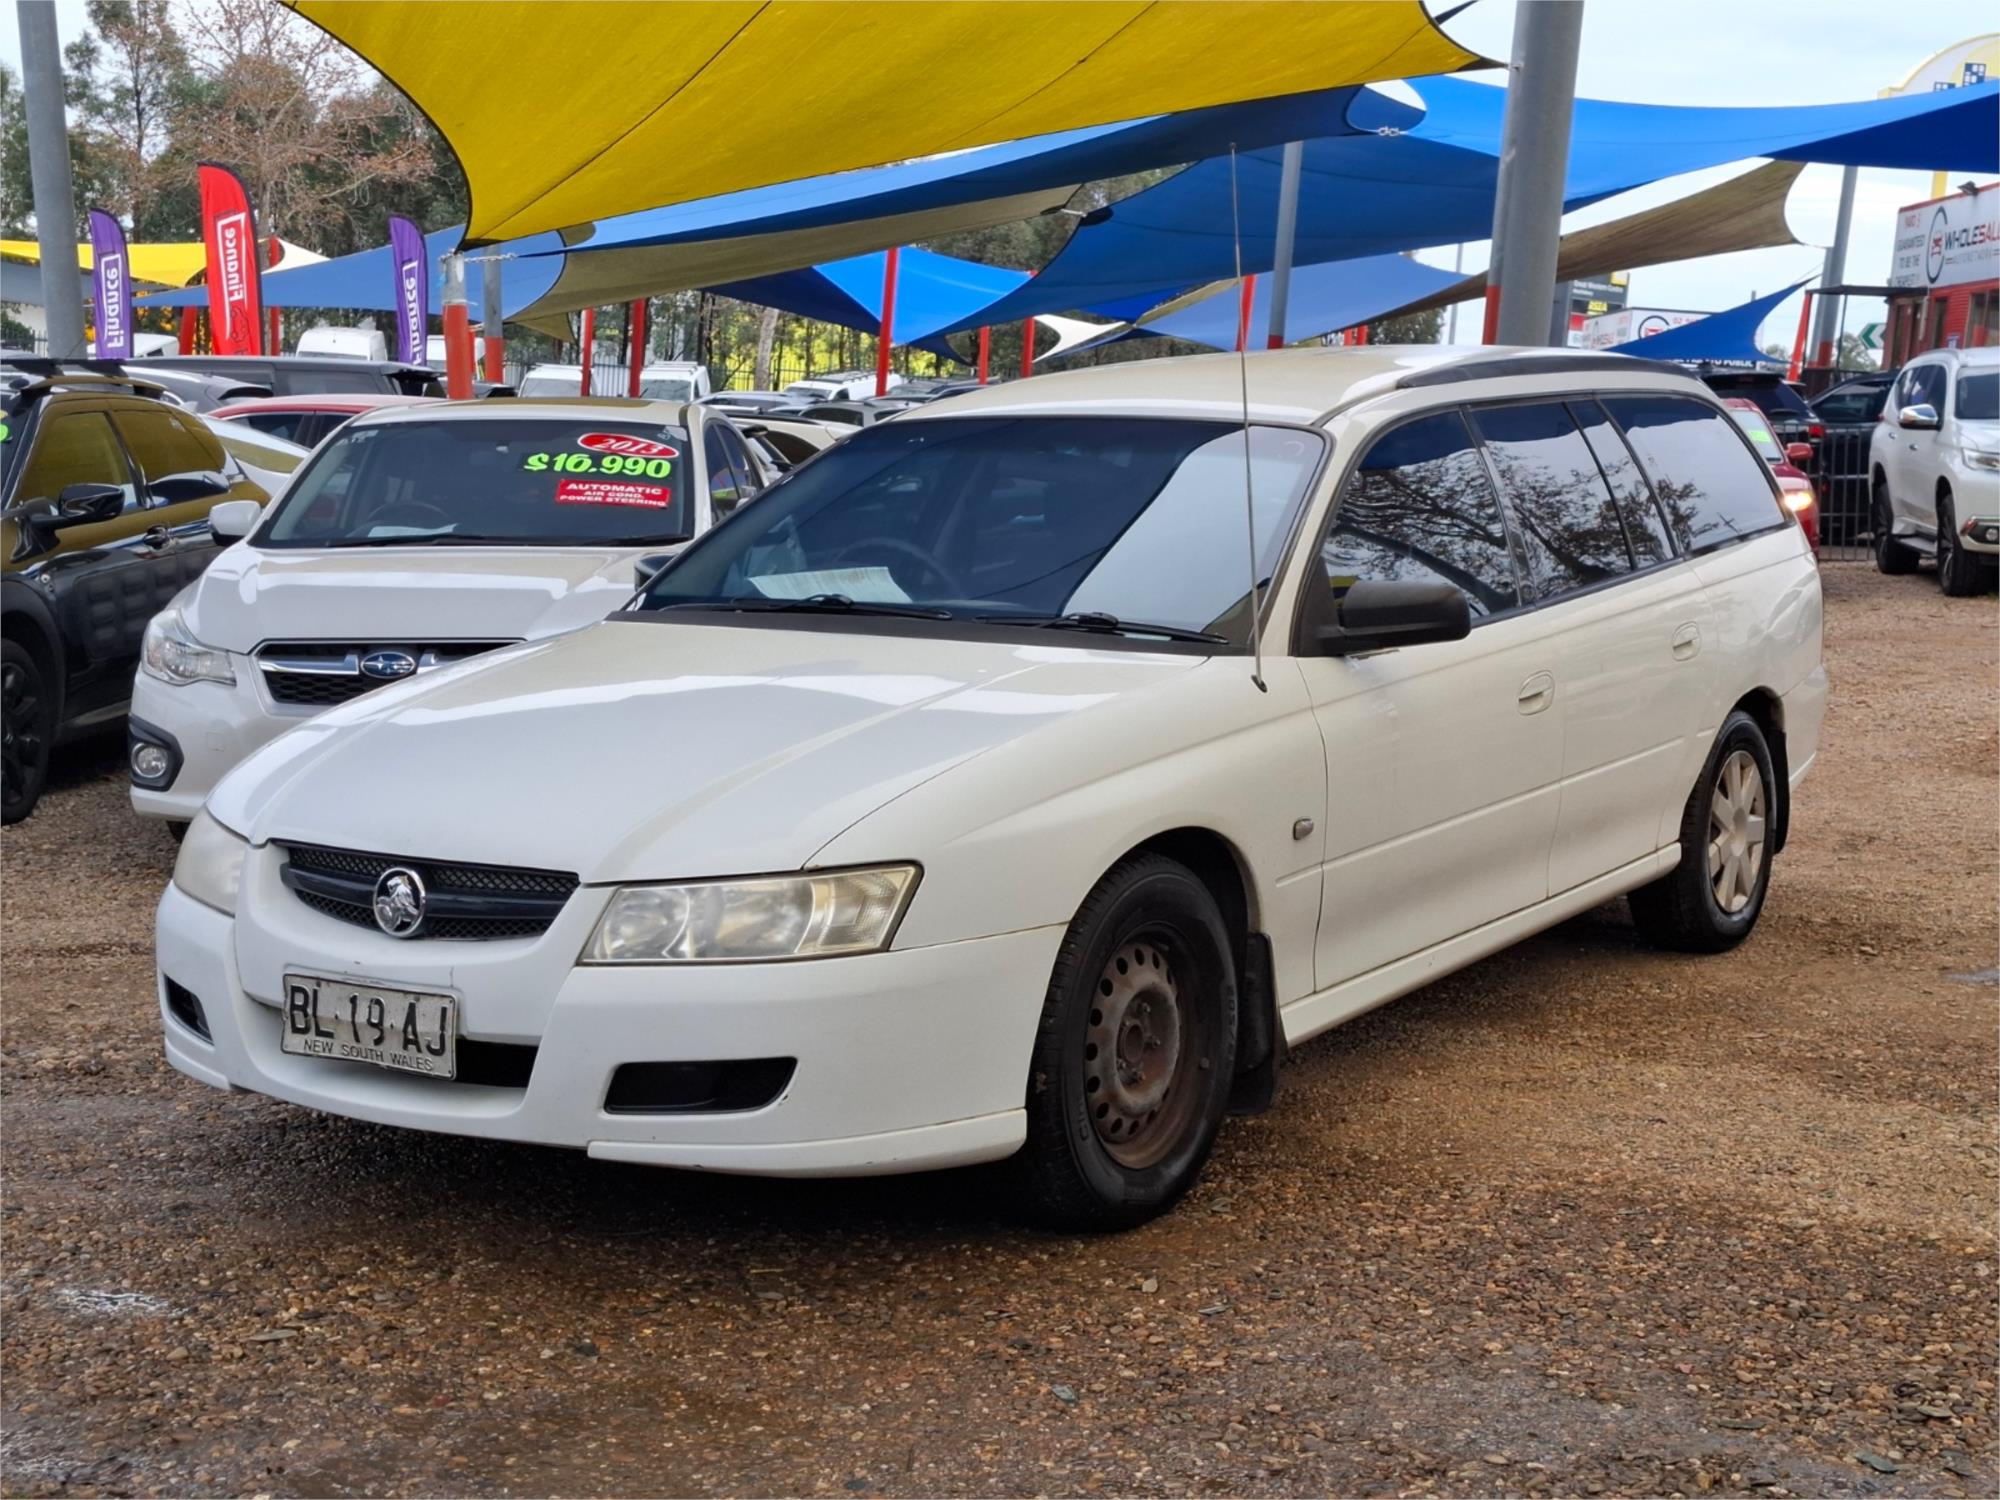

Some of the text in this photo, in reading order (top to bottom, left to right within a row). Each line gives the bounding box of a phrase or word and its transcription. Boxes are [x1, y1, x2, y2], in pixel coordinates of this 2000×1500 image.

[595, 438, 663, 453] 2013
[566, 483, 662, 495] AUTOMATIC
[606, 497, 666, 506] STEERING
[290, 985, 447, 1057] BL 19 AJ
[304, 1040, 433, 1072] NEW SOUTH WALES
